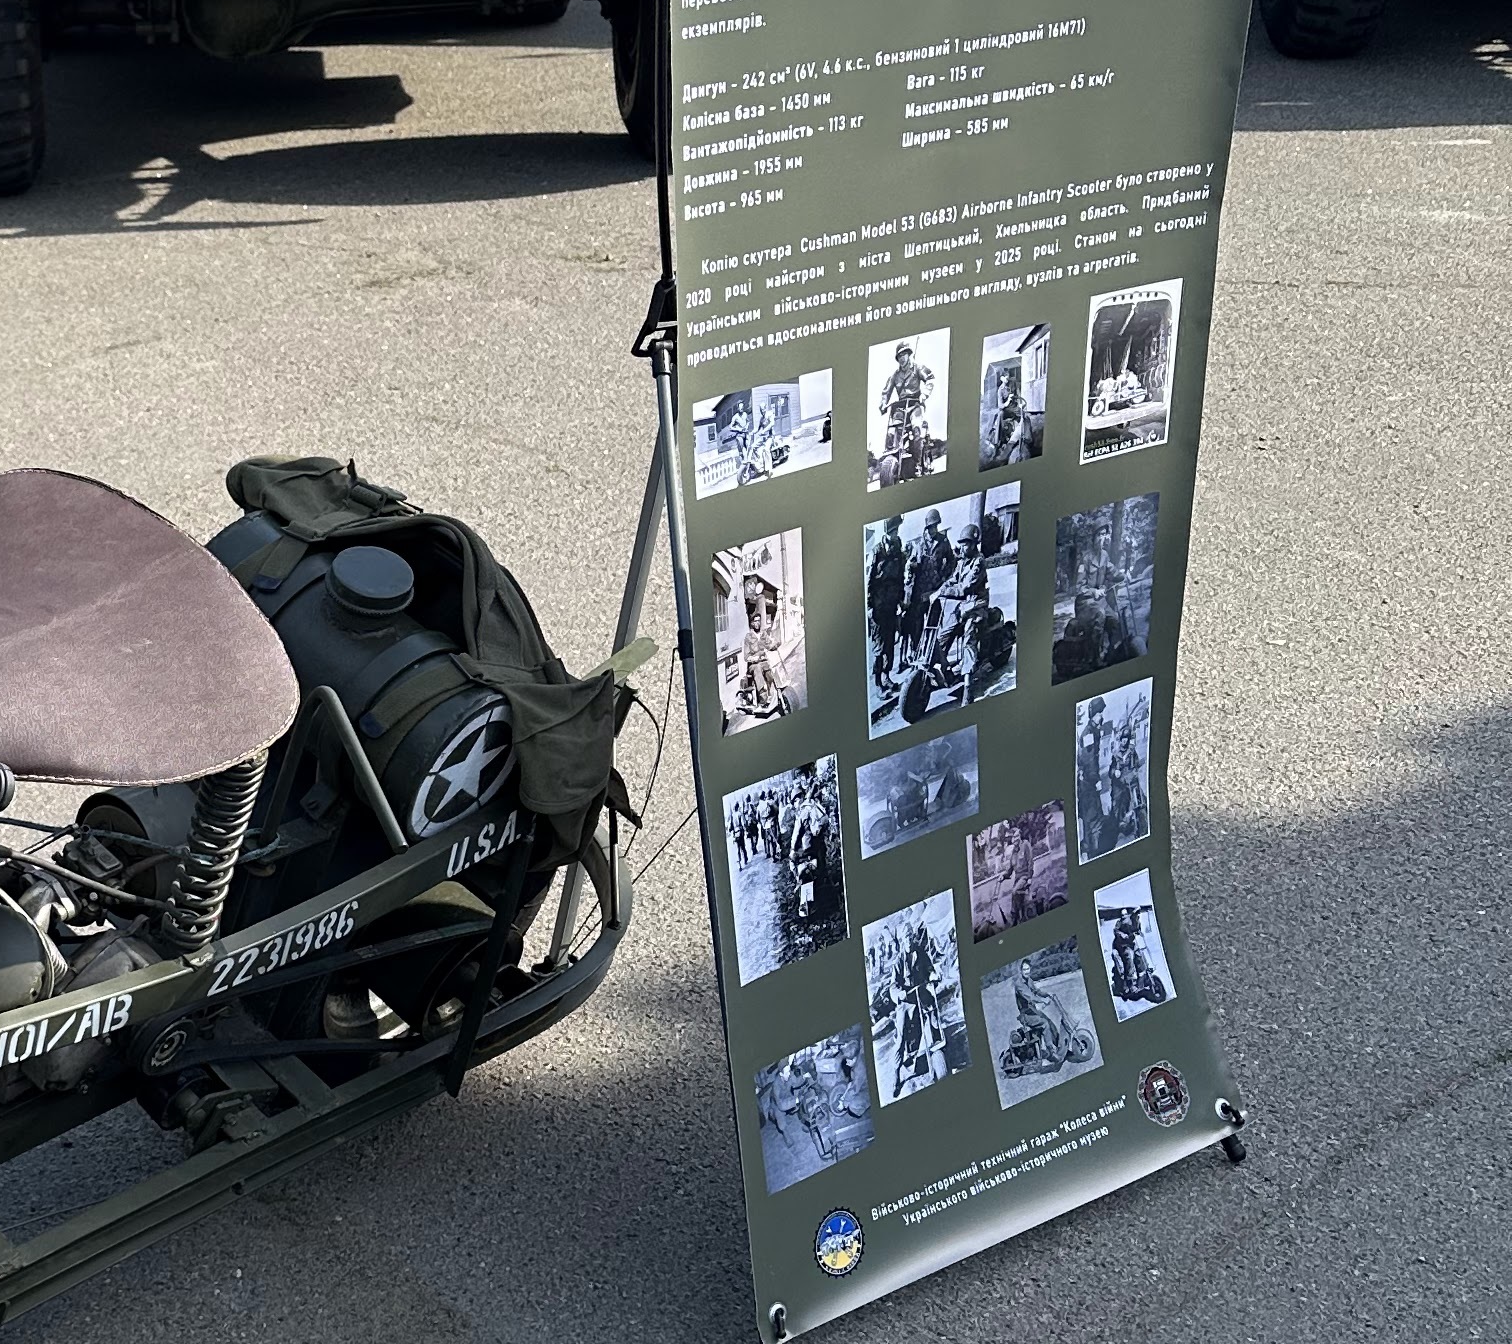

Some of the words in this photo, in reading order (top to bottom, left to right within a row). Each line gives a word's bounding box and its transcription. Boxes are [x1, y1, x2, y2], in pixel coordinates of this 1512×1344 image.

[681, 12, 767, 40] екземплярів.
[682, 81, 727, 104] Двигун
[742, 71, 766, 90] 242
[822, 58, 842, 75] 4.6
[875, 38, 951, 66] бензиновий
[963, 23, 1044, 54] циліндровий
[904, 93, 989, 118] Максимальна
[992, 82, 1055, 104] швидкість
[1070, 73, 1085, 90] 65
[906, 74, 935, 90] Вага
[949, 65, 967, 82] 115
[971, 66, 986, 79] кг
[682, 111, 731, 131] Колісна
[734, 104, 765, 121] база
[781, 92, 810, 112] 1450
[813, 92, 831, 106] мм
[828, 115, 846, 132] 113
[850, 115, 864, 129] кг
[901, 128, 951, 148] Ширина
[966, 117, 989, 135] 585
[992, 117, 1009, 130] мм
[683, 169, 738, 194] Довжина
[753, 154, 781, 176] 1955
[785, 156, 803, 170] мм
[683, 201, 726, 221] Висота
[740, 189, 762, 208] 965
[766, 189, 784, 203] мм
[685, 287, 712, 309] 2020
[724, 277, 752, 302] році
[765, 265, 825, 289] майстром
[838, 261, 846, 273] з
[858, 251, 891, 268] міста
[903, 227, 983, 259] Шептицький,
[1079, 203, 1129, 222] область.
[1141, 184, 1210, 212] Придбаний
[701, 254, 739, 275] Копію
[742, 244, 792, 267] скутера
[800, 231, 857, 253] Cushman
[861, 219, 897, 240] Model
[901, 215, 915, 232] 53
[919, 205, 958, 230] (G683)
[961, 198, 1014, 220] Airborne
[1016, 188, 1064, 208] Infantry
[1066, 179, 1113, 198] Scooter
[1115, 173, 1143, 191] було
[1146, 164, 1202, 183] створено
[1205, 163, 1215, 177] у
[686, 308, 761, 338] Українським
[773, 275, 910, 316] військово-історичним
[975, 258, 983, 274] у
[994, 246, 1022, 266] 2025
[1033, 238, 1062, 261] році.
[1074, 229, 1117, 249] Станом
[1128, 226, 1143, 238] на
[1154, 211, 1209, 233] сьогодні
[686, 336, 764, 367] проводиться
[767, 312, 862, 346] вдосконалення
[865, 305, 893, 322] його
[895, 288, 970, 315] зовнішнього
[1026, 265, 1063, 288] вузлів
[1066, 264, 1080, 277] та
[1082, 250, 1140, 274] агрегатів.
[446, 810, 523, 879] U.S.A.
[206, 900, 360, 998] 2231986
[871, 1161, 980, 1221] Військово-історичний
[980, 1139, 1029, 1172] технічний
[1030, 1127, 1060, 1150] гараж
[902, 1189, 968, 1226] Українського
[969, 1139, 1078, 1197] військово-історичного
[1080, 1125, 1110, 1148] музею
